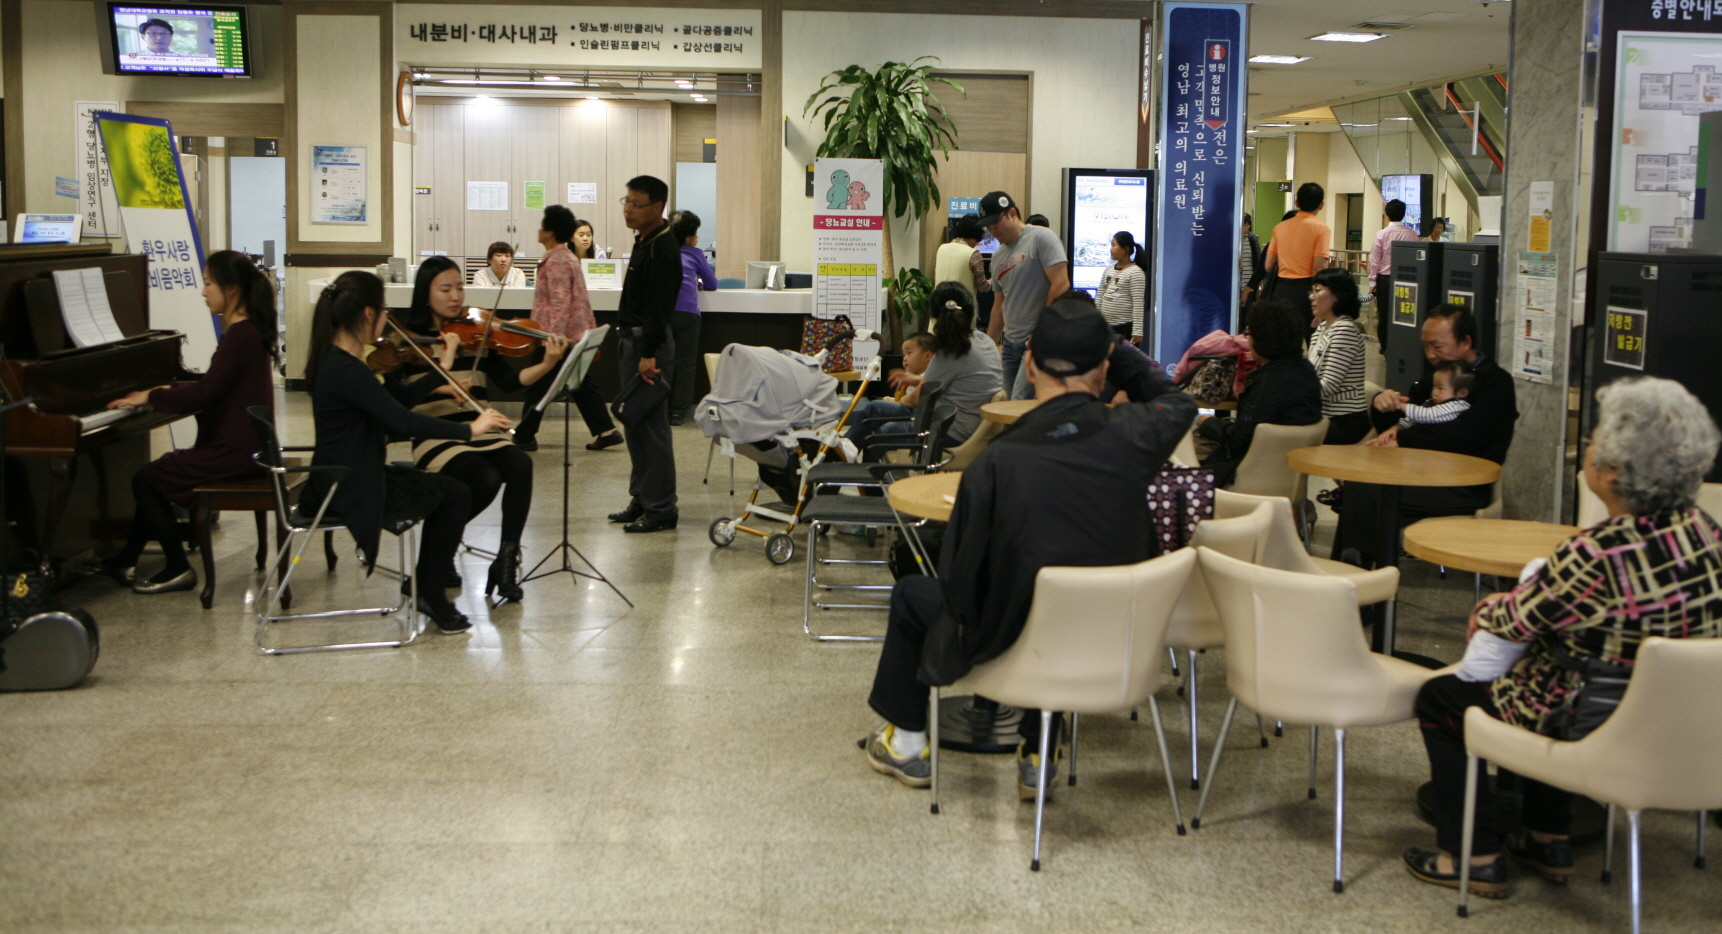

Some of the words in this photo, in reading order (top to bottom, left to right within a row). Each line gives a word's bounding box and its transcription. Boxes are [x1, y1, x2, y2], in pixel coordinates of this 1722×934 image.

[410, 23, 558, 44] 내분비·대사내과
[579, 22, 664, 34] 당뇨병·비만클리닉
[682, 25, 753, 36] 골다공증클리닉
[682, 42, 743, 53] 갑상선클리닉
[1177, 62, 1191, 95] 영남
[1208, 63, 1226, 73] 병원
[1210, 74, 1221, 117] 정보안내
[1175, 103, 1190, 152] 최고의
[1212, 121, 1228, 165] 전은
[1173, 160, 1188, 209] 의료원
[951, 201, 977, 210] 진료비
[1191, 170, 1206, 237] 신뢰받는
[825, 218, 854, 227] 당뇨교실
[856, 218, 870, 227] 안내
[148, 267, 197, 290] 비음악회
